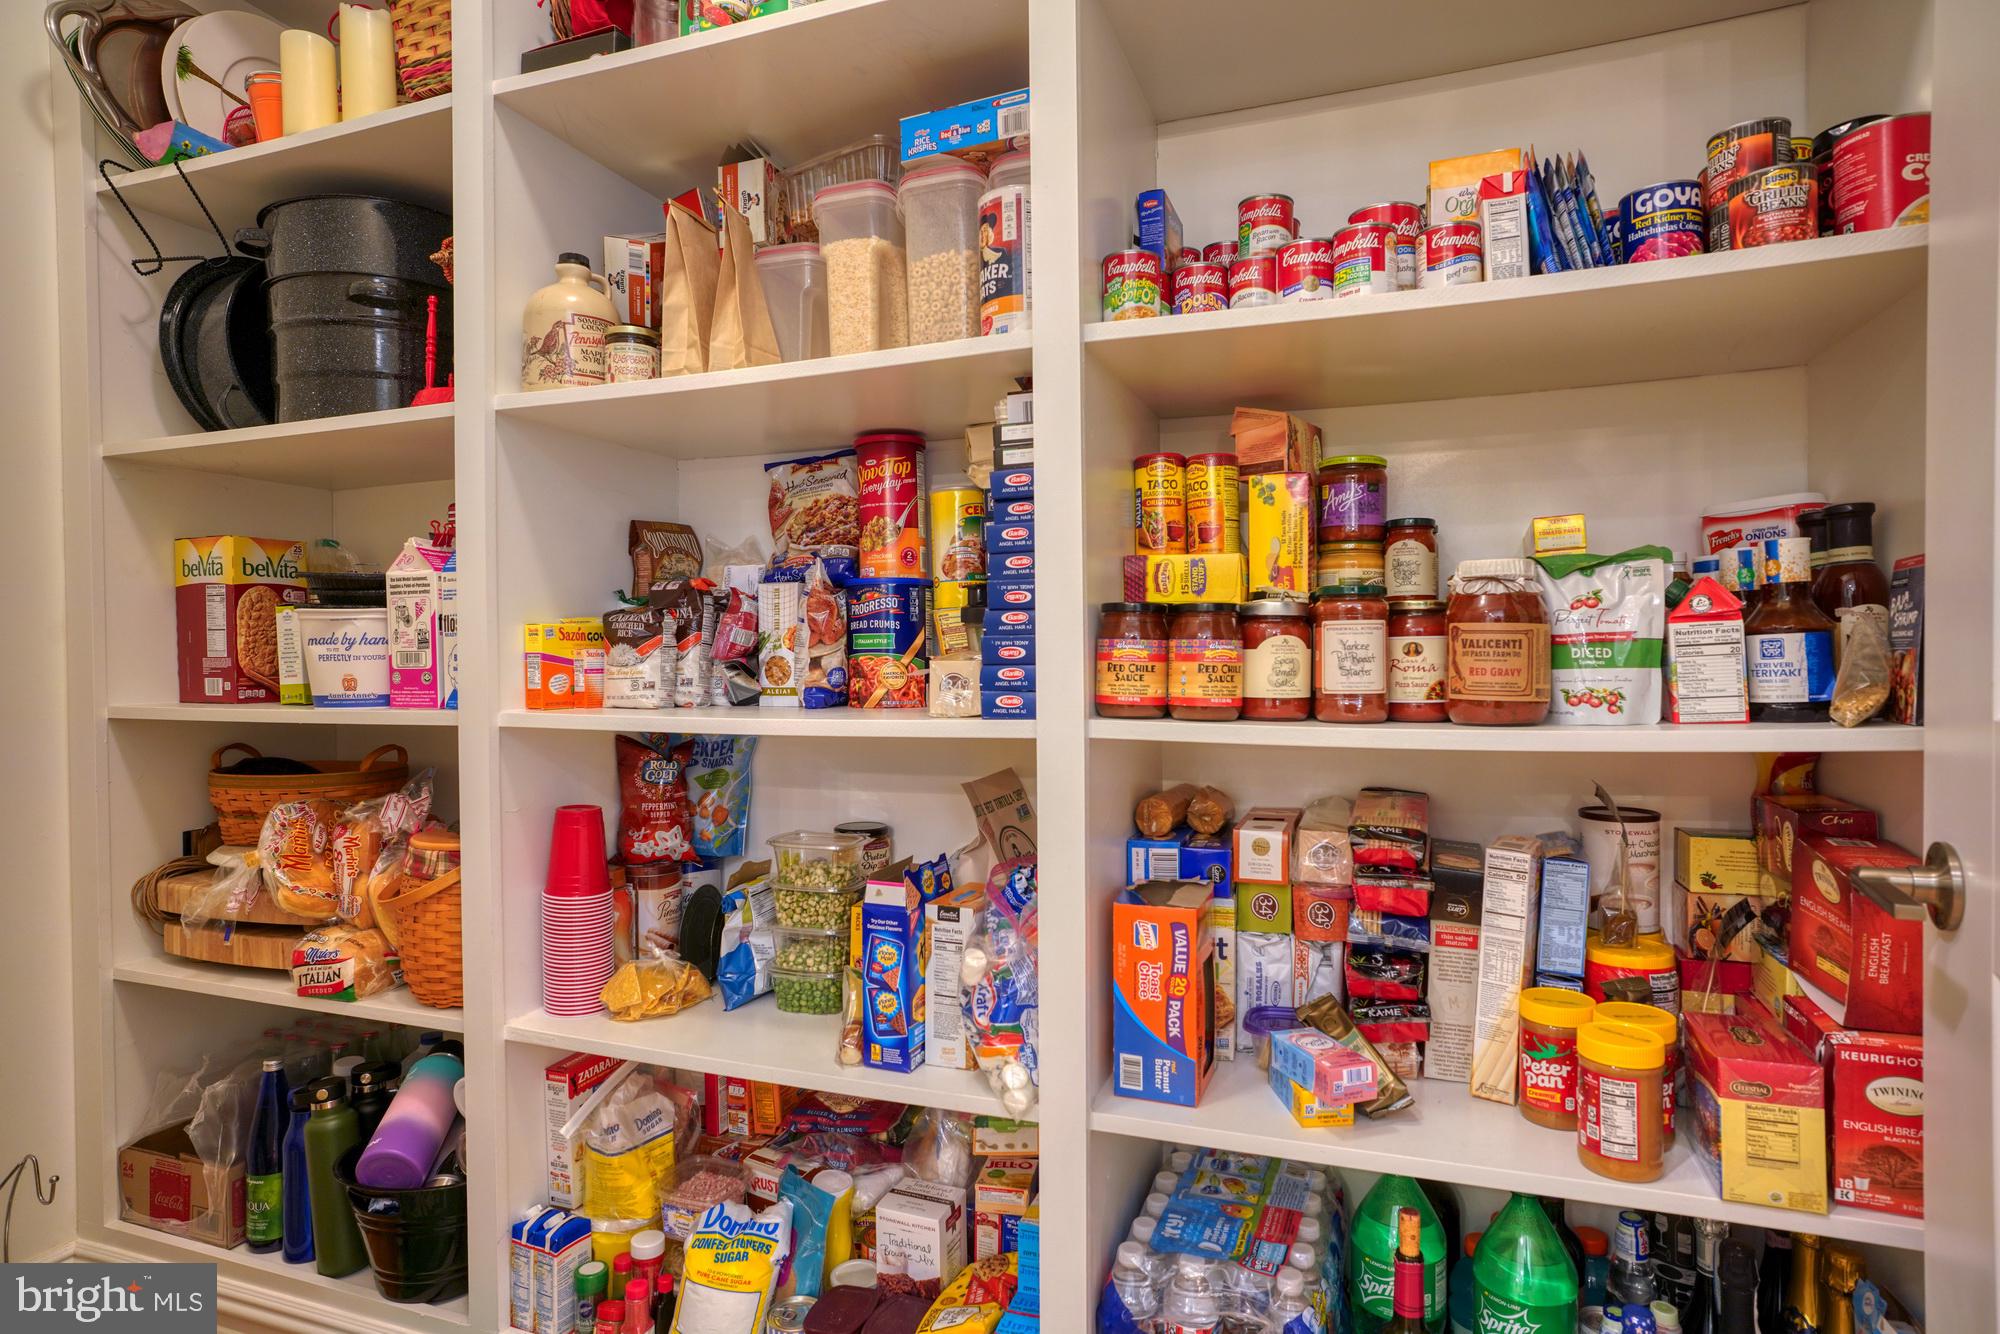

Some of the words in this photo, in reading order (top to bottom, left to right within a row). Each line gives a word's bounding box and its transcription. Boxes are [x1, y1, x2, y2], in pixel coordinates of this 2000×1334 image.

[914, 136, 930, 145] RICE
[908, 143, 937, 157] KRISPIES
[1765, 172, 1797, 184] BUSH'S
[1636, 187, 1702, 213] GOYA
[1760, 197, 1806, 214] BEANS
[1240, 204, 1284, 224] Campbell's
[1635, 217, 1651, 229] Red
[1654, 213, 1684, 226] Kidney
[1629, 223, 1678, 242] Habichuelas
[1108, 259, 1157, 276] Campbell's
[1435, 260, 1453, 269] GREAT
[1176, 271, 1223, 288] Campbell's
[806, 470, 848, 487] Seasoned
[1147, 480, 1177, 490] TACO
[1323, 483, 1367, 519] Amy's
[1710, 531, 1742, 547] French's
[1745, 529, 1787, 542] ONIONS
[182, 551, 223, 577] belVita
[242, 554, 298, 579] belVita
[851, 597, 898, 615] PROGRESSO
[1553, 608, 1594, 626] Perfect
[612, 622, 645, 630] ENRICHED
[850, 621, 868, 630] BREAD
[870, 619, 900, 629] CRUMBS
[559, 627, 586, 641] Sazón
[587, 632, 604, 641] GOY
[617, 630, 633, 638] RICE
[1675, 628, 1713, 636] Nutrition
[308, 632, 339, 646] made
[341, 632, 357, 651] by
[1340, 639, 1370, 650] Yankee
[1461, 638, 1523, 649] VALICENTI
[1571, 647, 1612, 659] DICED
[1730, 646, 1741, 654] 20
[318, 654, 351, 662] PERFECTLY
[1331, 650, 1350, 663] Pot
[1351, 653, 1376, 664] Roast
[1108, 663, 1125, 672] RED
[1128, 664, 1156, 673] CHILE
[1198, 664, 1218, 673] RED
[1340, 666, 1372, 677] Starter
[1390, 658, 1439, 673] Roma
[1469, 667, 1487, 676] RED
[1490, 668, 1522, 677] GRAVY
[1115, 673, 1145, 682] SAUCE
[1208, 674, 1235, 683] SAUCE
[1751, 668, 1801, 678] TERIYAKI
[1395, 681, 1410, 689] Pizza
[650, 760, 678, 770] ROLD
[702, 755, 733, 768] SNACKS
[645, 769, 678, 781] GOLD
[642, 802, 677, 811] PEPPERMINT
[1821, 815, 1854, 825] Chai
[1489, 853, 1511, 862] Nutrition
[1512, 856, 1529, 864] Facts
[861, 862, 877, 871] Dip
[1487, 871, 1513, 880] Calories
[1516, 873, 1526, 881] 50
[1800, 895, 1827, 918] ENGLISH
[1440, 933, 1453, 941] thin
[1454, 935, 1473, 943] salted
[1174, 929, 1186, 974] VALUE
[1869, 938, 1880, 978] ENGLISH
[1879, 932, 1892, 985] BREAKFAST
[299, 968, 341, 986] ITALIAN
[1138, 961, 1149, 999] Chee
[1150, 963, 1162, 1002] Toast
[1175, 977, 1187, 996] 20
[1168, 1000, 1181, 1039] PACK
[1841, 1051, 1895, 1064] KEURIG
[1521, 1053, 1571, 1076] Peter
[1162, 1060, 1171, 1093] Peanut
[1732, 1082, 1768, 1094] CELESTIAL
[1871, 1087, 1923, 1099] TWINING
[635, 1108, 662, 1131] Domino
[642, 1118, 663, 1134] SUGAR
[1843, 1120, 1893, 1134] ENGLISH
[123, 1162, 134, 1172] 24
[1839, 1178, 1854, 1188] 18
[704, 1203, 779, 1235] Domino
[912, 1223, 936, 1232] KITCHEN
[692, 1238, 772, 1254] CONFECTIONERS
[884, 1233, 931, 1254] Traditional
[714, 1252, 748, 1263] SUGAR
[881, 1243, 913, 1261] Brownie
[916, 1254, 934, 1266] Mix
[697, 1271, 710, 1279] PURE
[1361, 1273, 1394, 1296] Spri
[1481, 1308, 1530, 1334] Sprite
